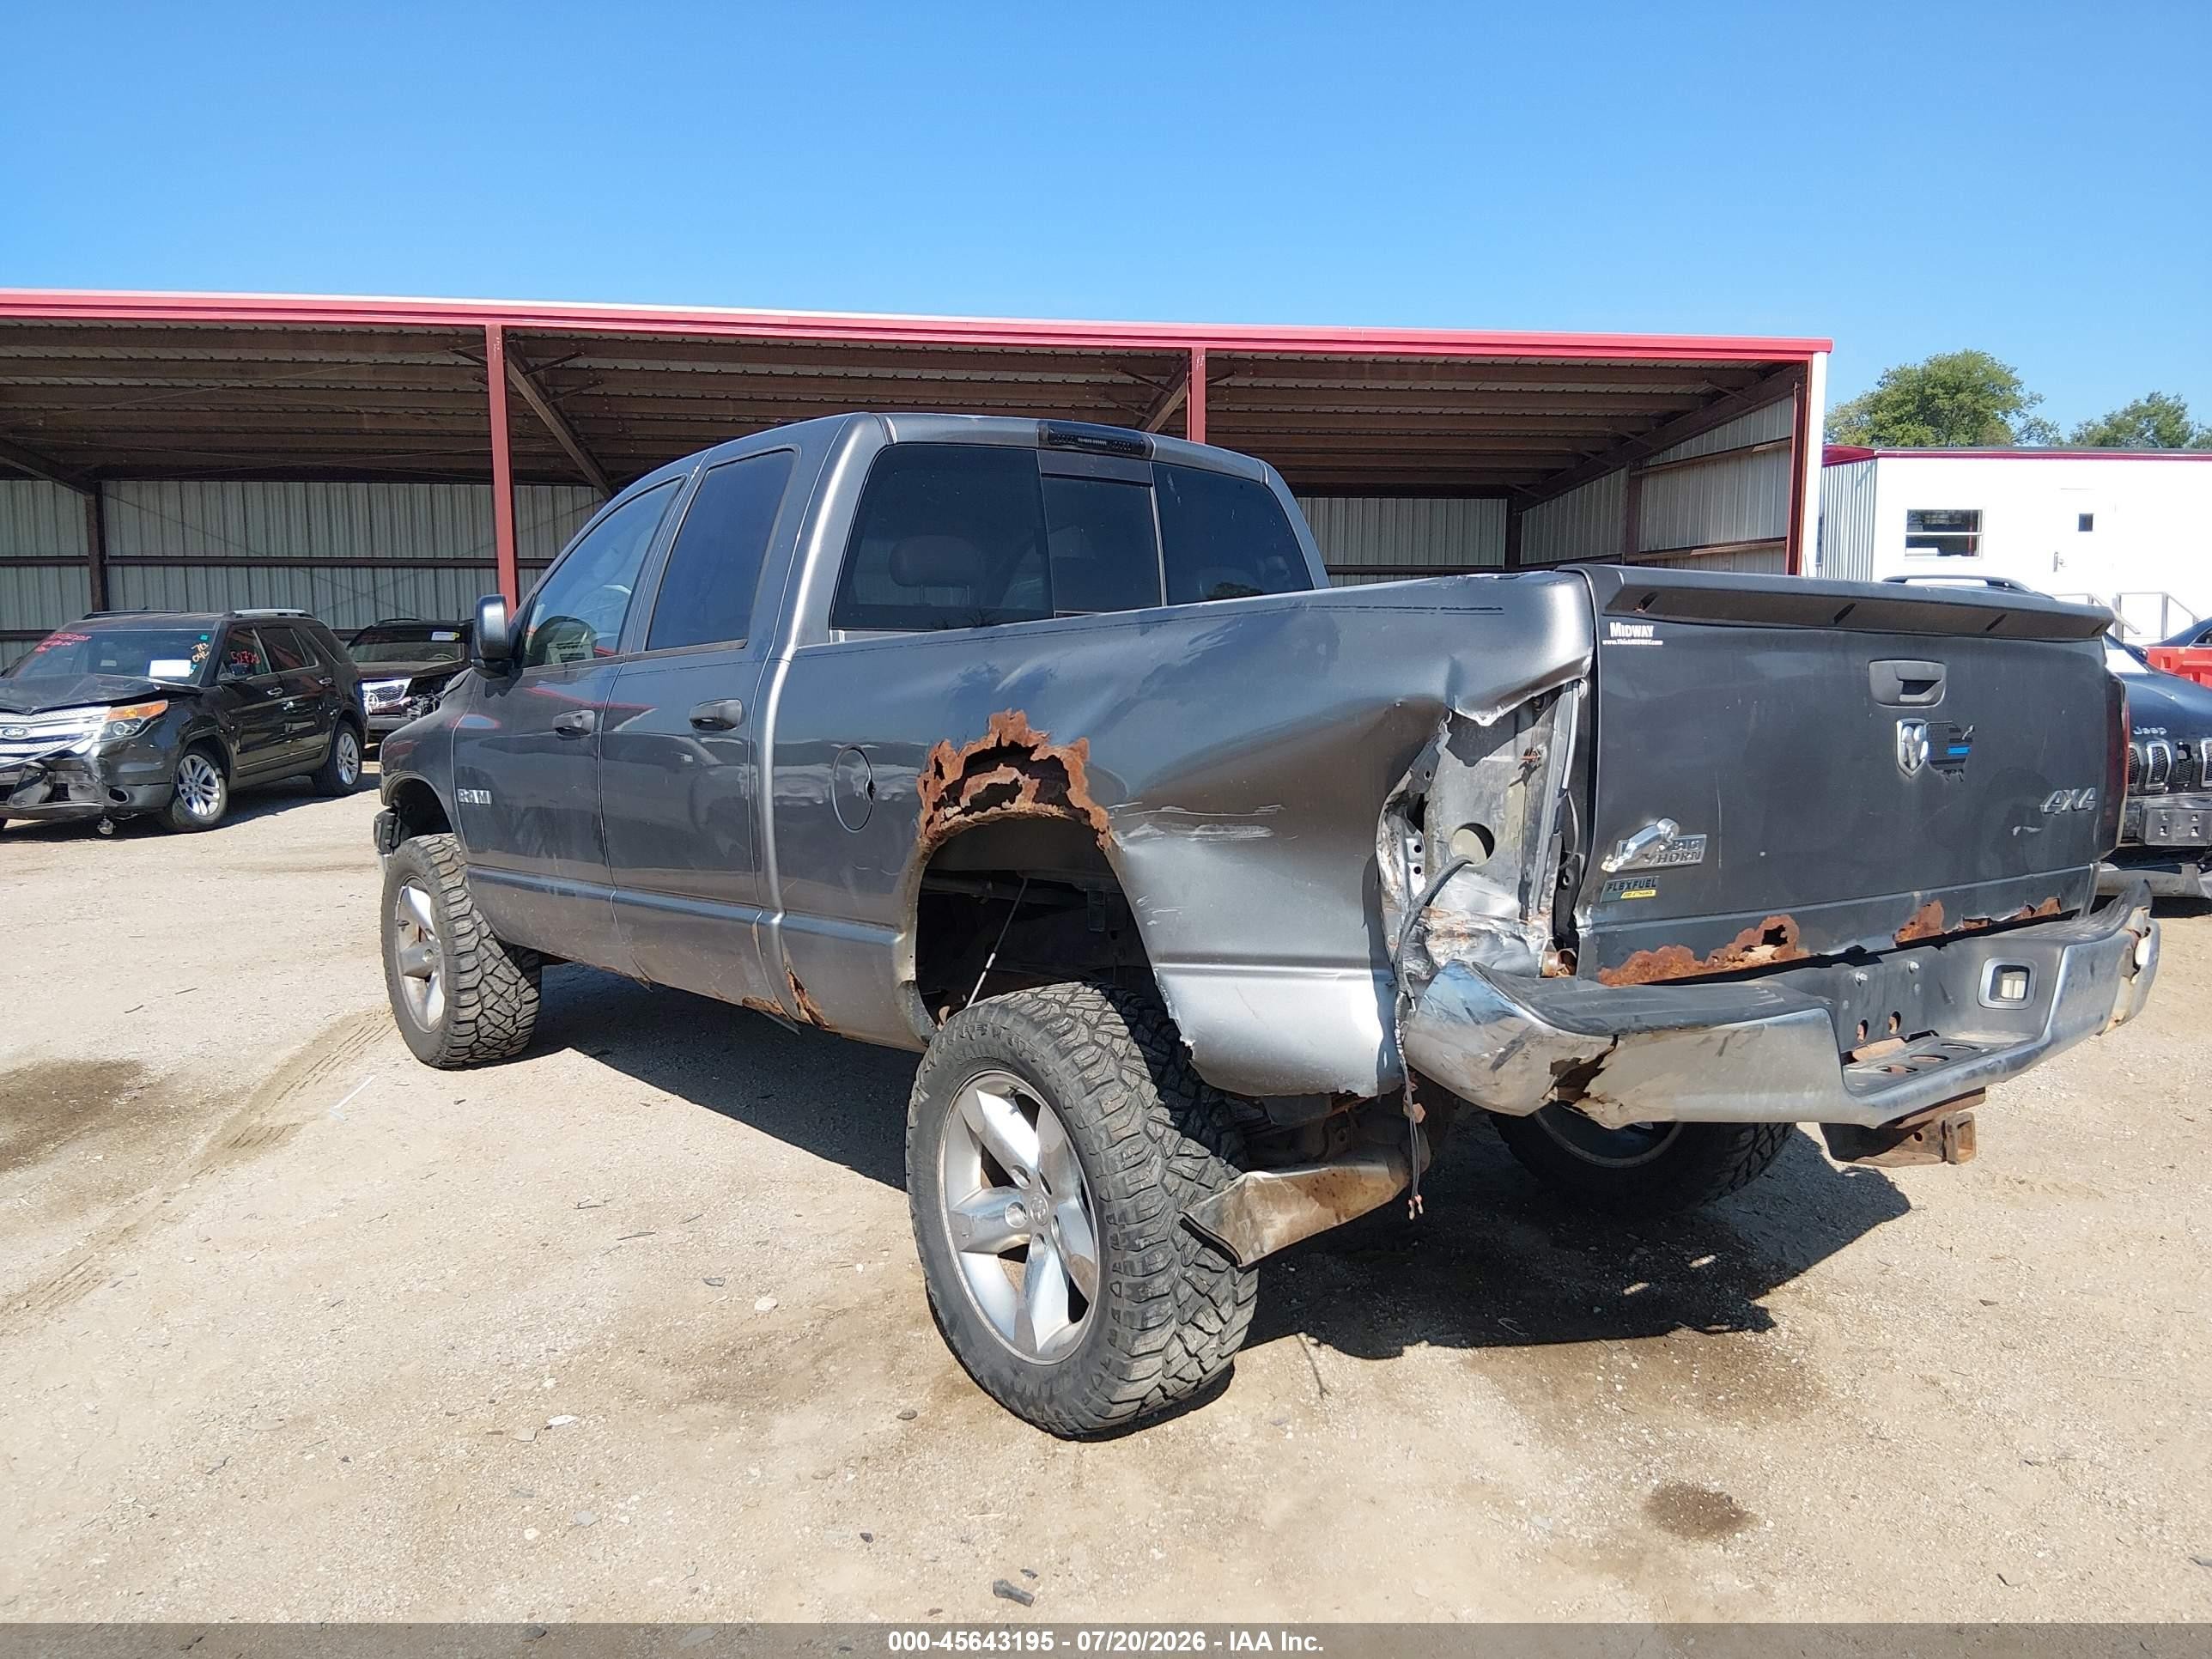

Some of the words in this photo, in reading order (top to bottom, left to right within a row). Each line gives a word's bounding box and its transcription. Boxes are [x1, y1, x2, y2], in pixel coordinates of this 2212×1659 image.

[1609, 622, 1654, 637] MIDWAY
[2132, 726, 2167, 736] Jeep
[458, 788, 492, 805] RAM
[1656, 850, 1701, 864] HORN
